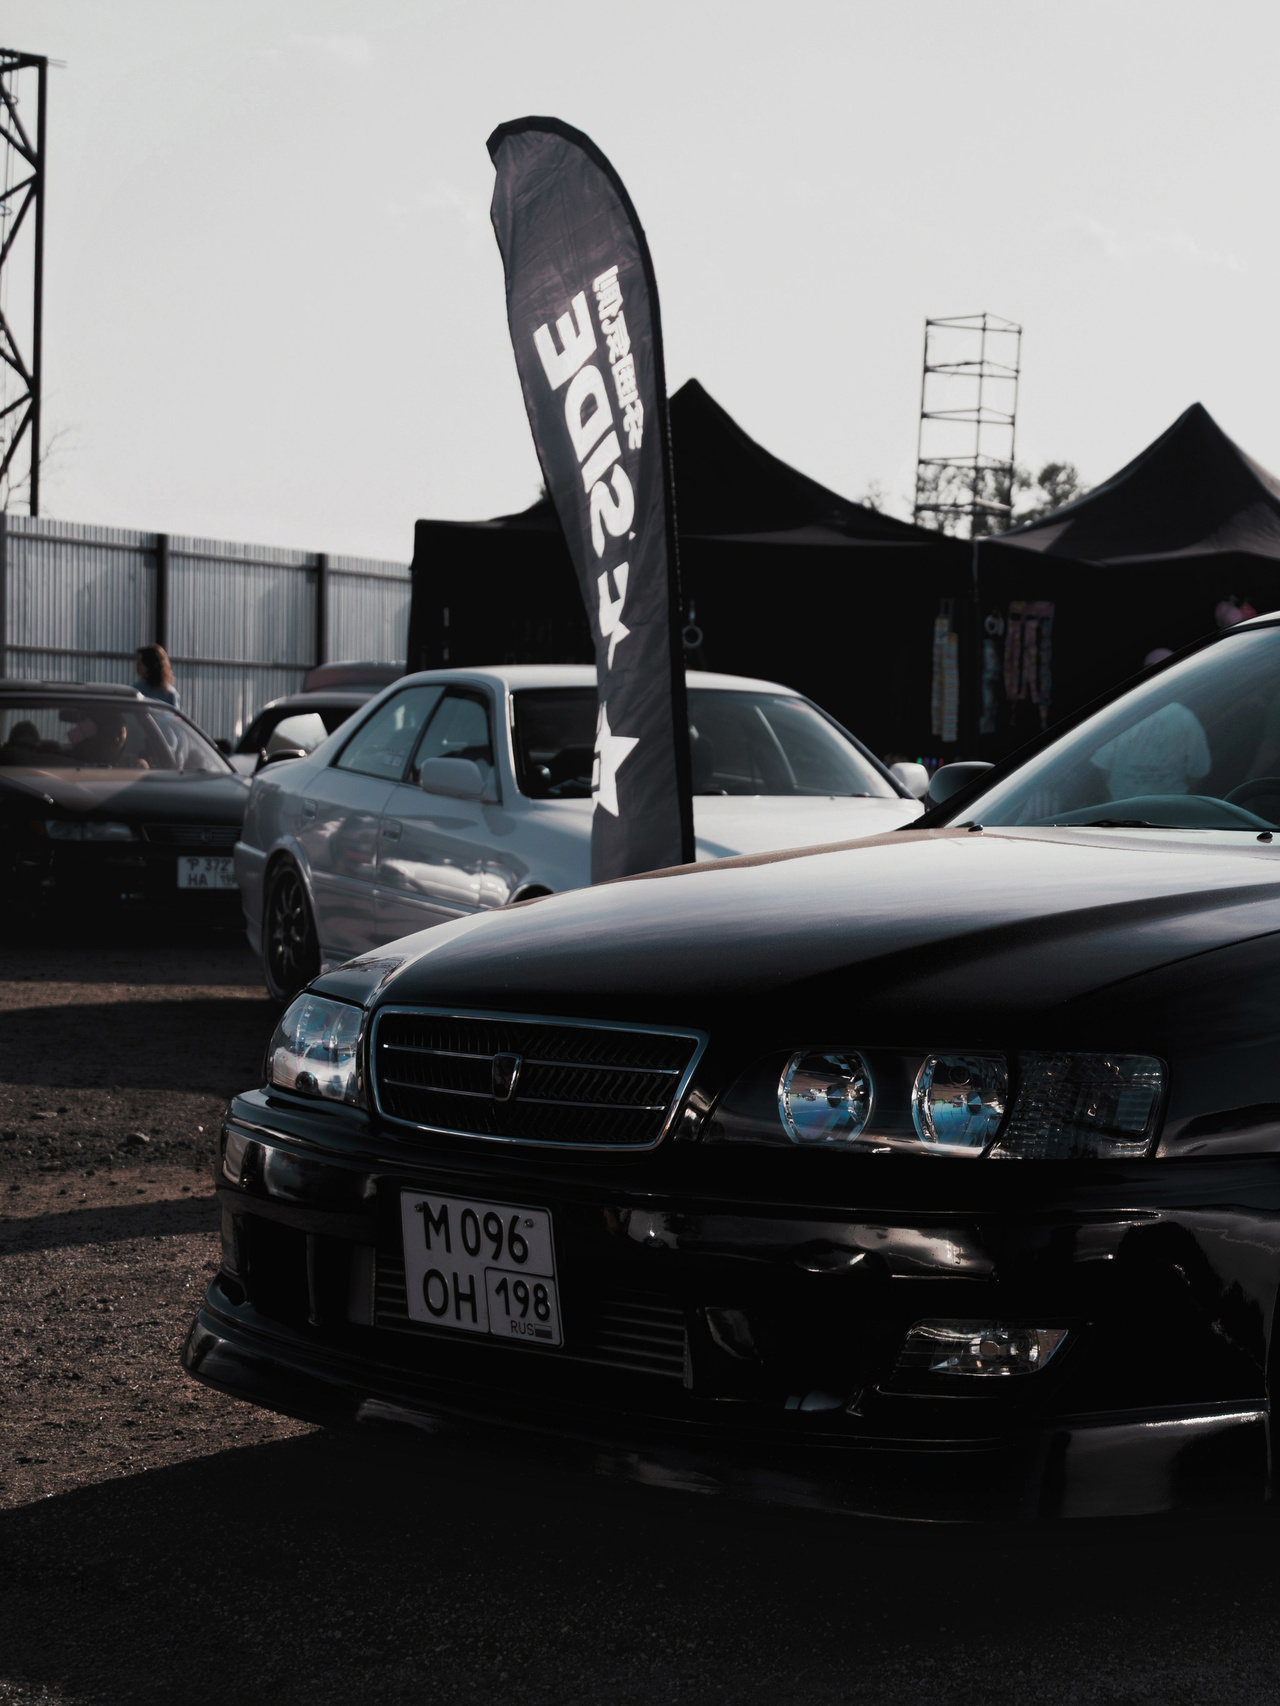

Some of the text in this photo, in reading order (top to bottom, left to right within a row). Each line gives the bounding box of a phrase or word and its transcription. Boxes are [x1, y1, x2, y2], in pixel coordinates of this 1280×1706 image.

[188, 873, 208, 886] HA
[423, 1268, 478, 1323] OH
[495, 1277, 550, 1322] 198
[510, 1320, 534, 1336] RUS
